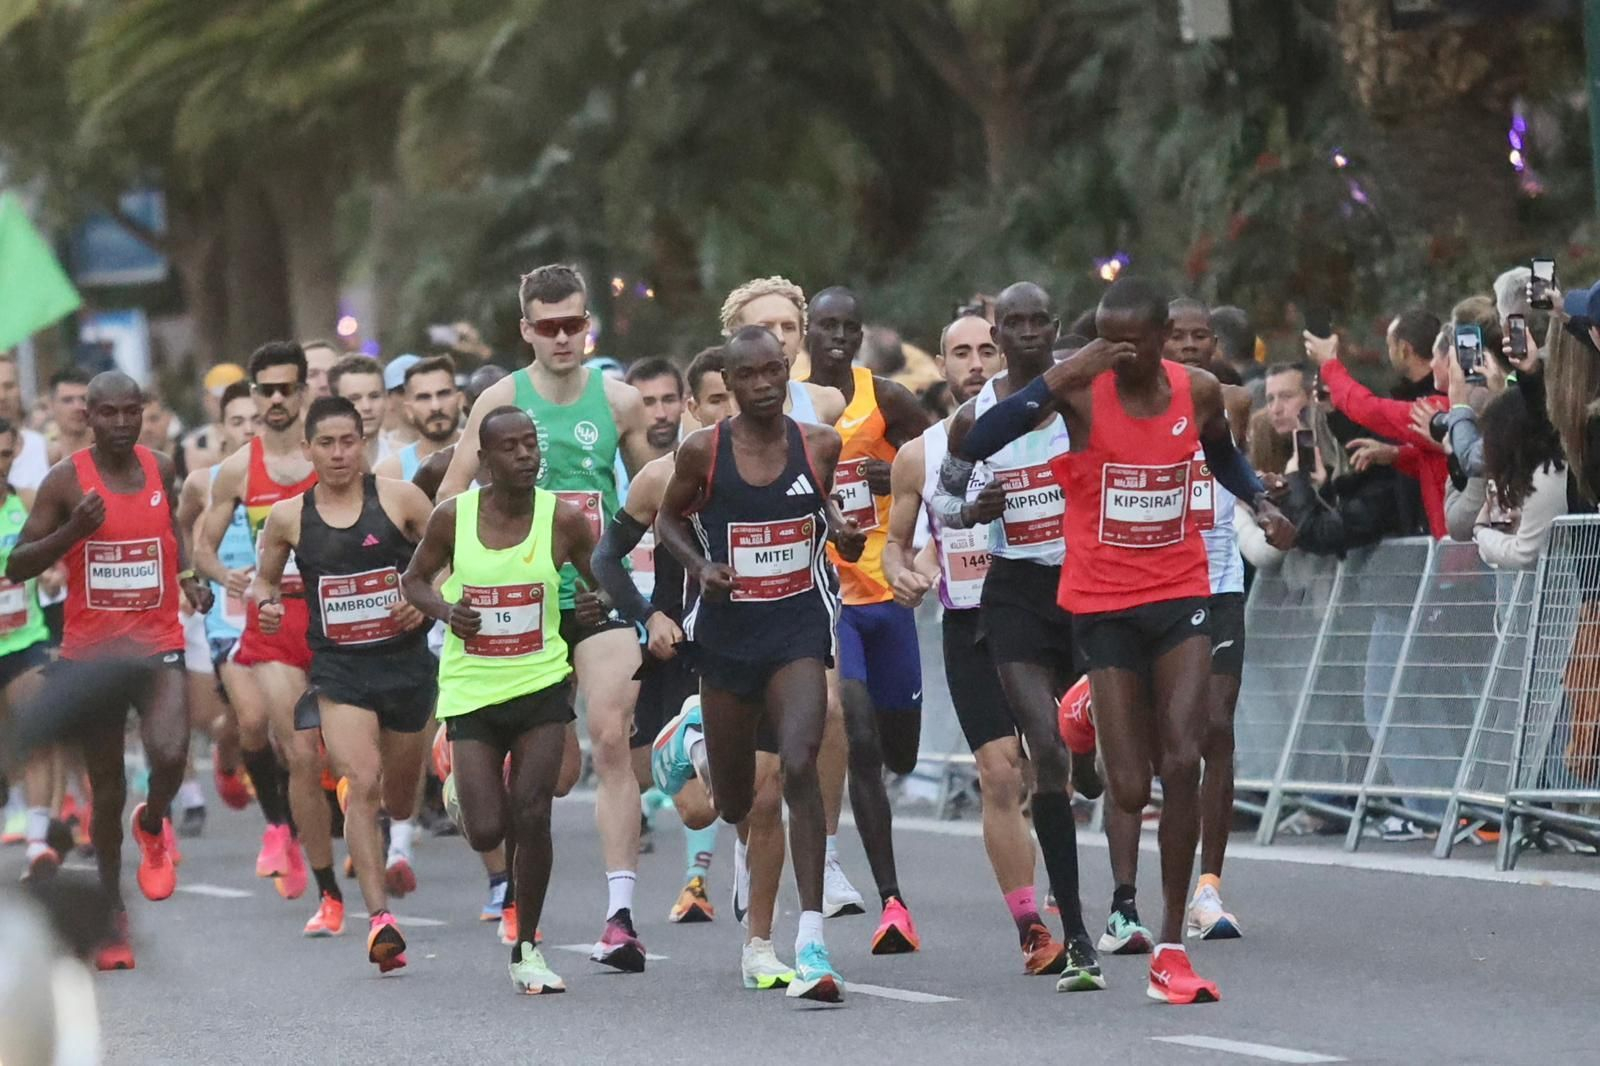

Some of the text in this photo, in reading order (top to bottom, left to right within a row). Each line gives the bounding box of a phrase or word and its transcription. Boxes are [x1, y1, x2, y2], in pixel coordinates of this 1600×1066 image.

[1113, 493, 1178, 509] KIPSIRAT
[754, 547, 794, 564] MITEI
[92, 563, 156, 578] MBURUGU
[326, 593, 397, 612] AMBROCIO
[495, 611, 512, 624] 16
